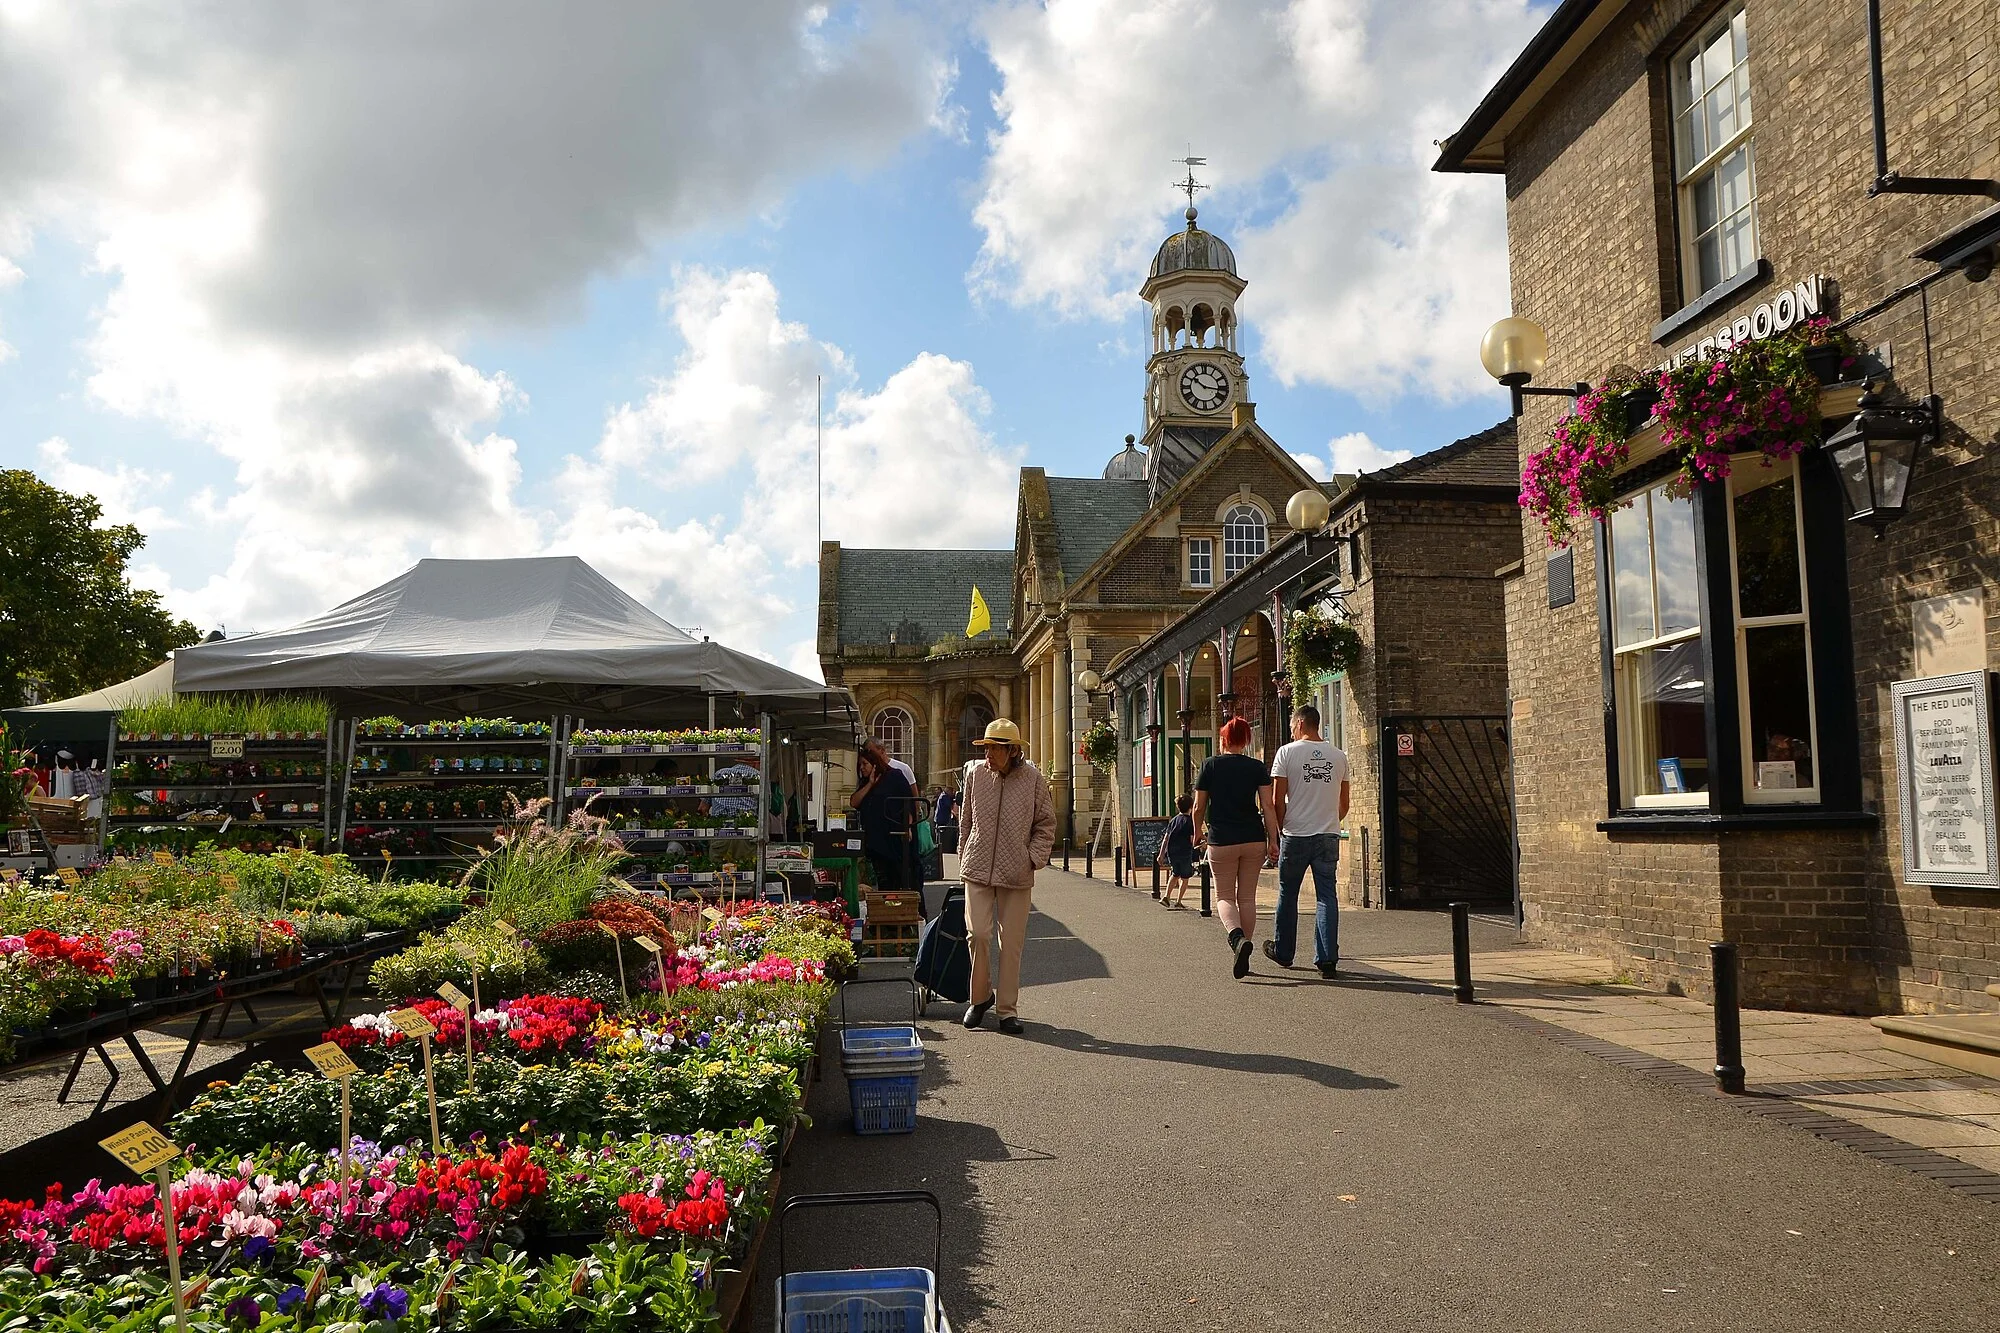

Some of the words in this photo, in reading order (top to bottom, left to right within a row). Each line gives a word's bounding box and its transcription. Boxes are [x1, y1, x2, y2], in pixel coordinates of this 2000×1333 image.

[1912, 702, 1928, 712] THE
[1931, 700, 1949, 710] RED
[1952, 696, 1974, 708] LION
[1934, 718, 1952, 728] FOOD
[1920, 728, 1942, 737] SERVED
[1944, 727, 1954, 735] ALL
[1956, 726, 1969, 734] DAY
[1922, 741, 1943, 750] FAMILY
[1944, 739, 1968, 748] DINING
[1926, 775, 1950, 784] GLOBAL
[1952, 774, 1970, 782] BEERS
[1922, 788, 1976, 797] AWARD-WINNING
[1939, 796, 1958, 804] WINES
[1926, 810, 1973, 818] WORLD-CLASS
[1940, 818, 1960, 826] SPIRITS
[1936, 831, 1950, 840] REAL
[1952, 831, 1966, 840] ALES
[1932, 844, 1946, 852] FREE
[1949, 844, 1972, 852] HOUSE
[398, 1016, 428, 1031] £2.00
[317, 1054, 350, 1072] £4.00
[106, 1136, 135, 1150] Winter
[128, 1127, 152, 1140] Pansy
[119, 1136, 169, 1165] £2.00
